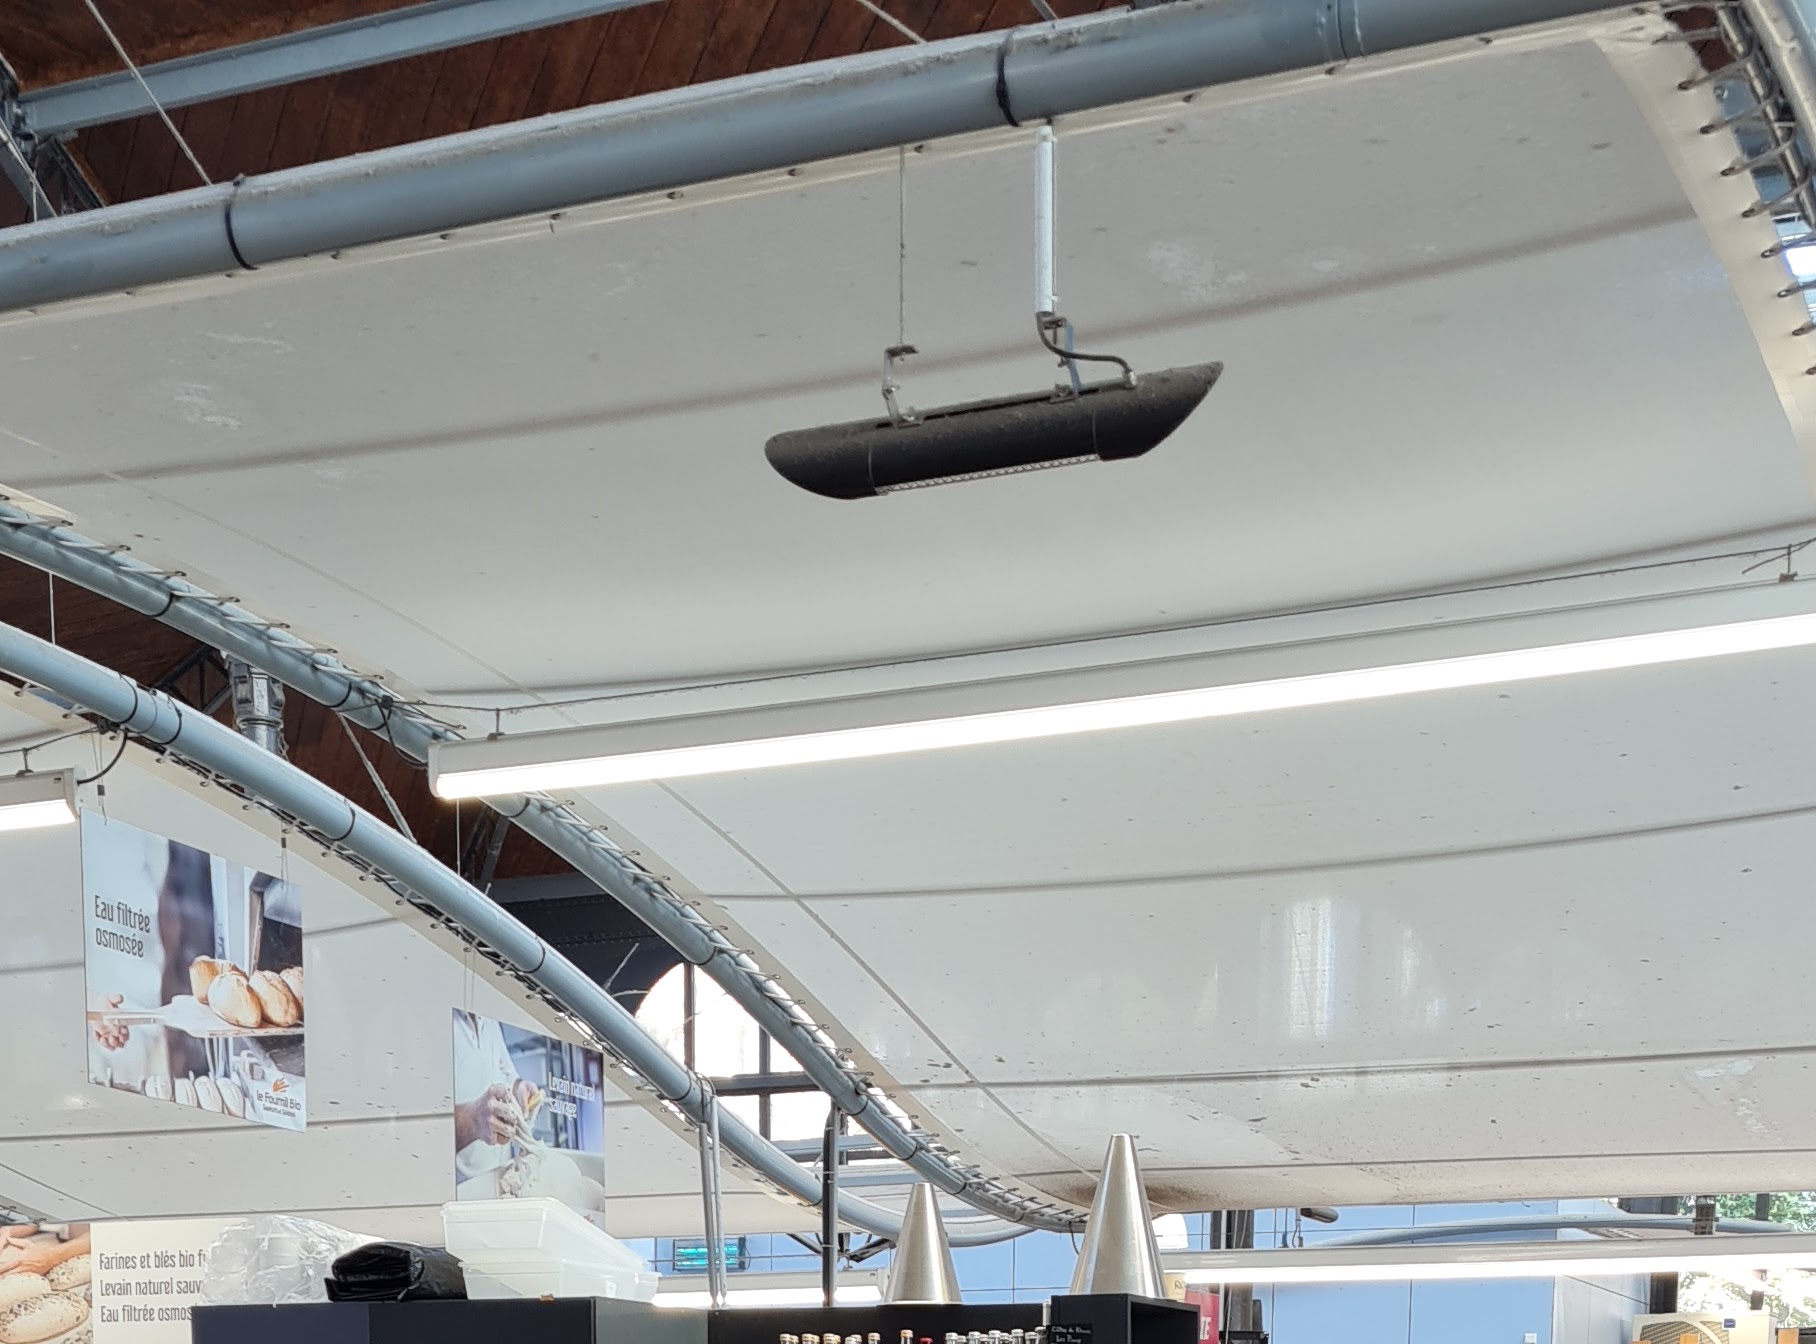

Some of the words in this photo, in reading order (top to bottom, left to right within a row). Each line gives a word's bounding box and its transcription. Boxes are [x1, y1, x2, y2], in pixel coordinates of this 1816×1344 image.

[95, 895, 114, 922] Eau
[117, 901, 150, 934] filtrée
[96, 928, 144, 958] osmosée
[290, 1098, 302, 1111] Bio
[100, 1252, 137, 1270] Farines
[140, 1253, 152, 1269] et
[154, 1249, 176, 1269] blés
[179, 1250, 195, 1268] bio
[100, 1278, 132, 1296] Levain
[135, 1276, 173, 1296] naturel
[176, 1280, 204, 1295] sauv
[101, 1305, 119, 1322] Eau
[122, 1303, 155, 1322] filtrée
[158, 1306, 193, 1322] osmos
